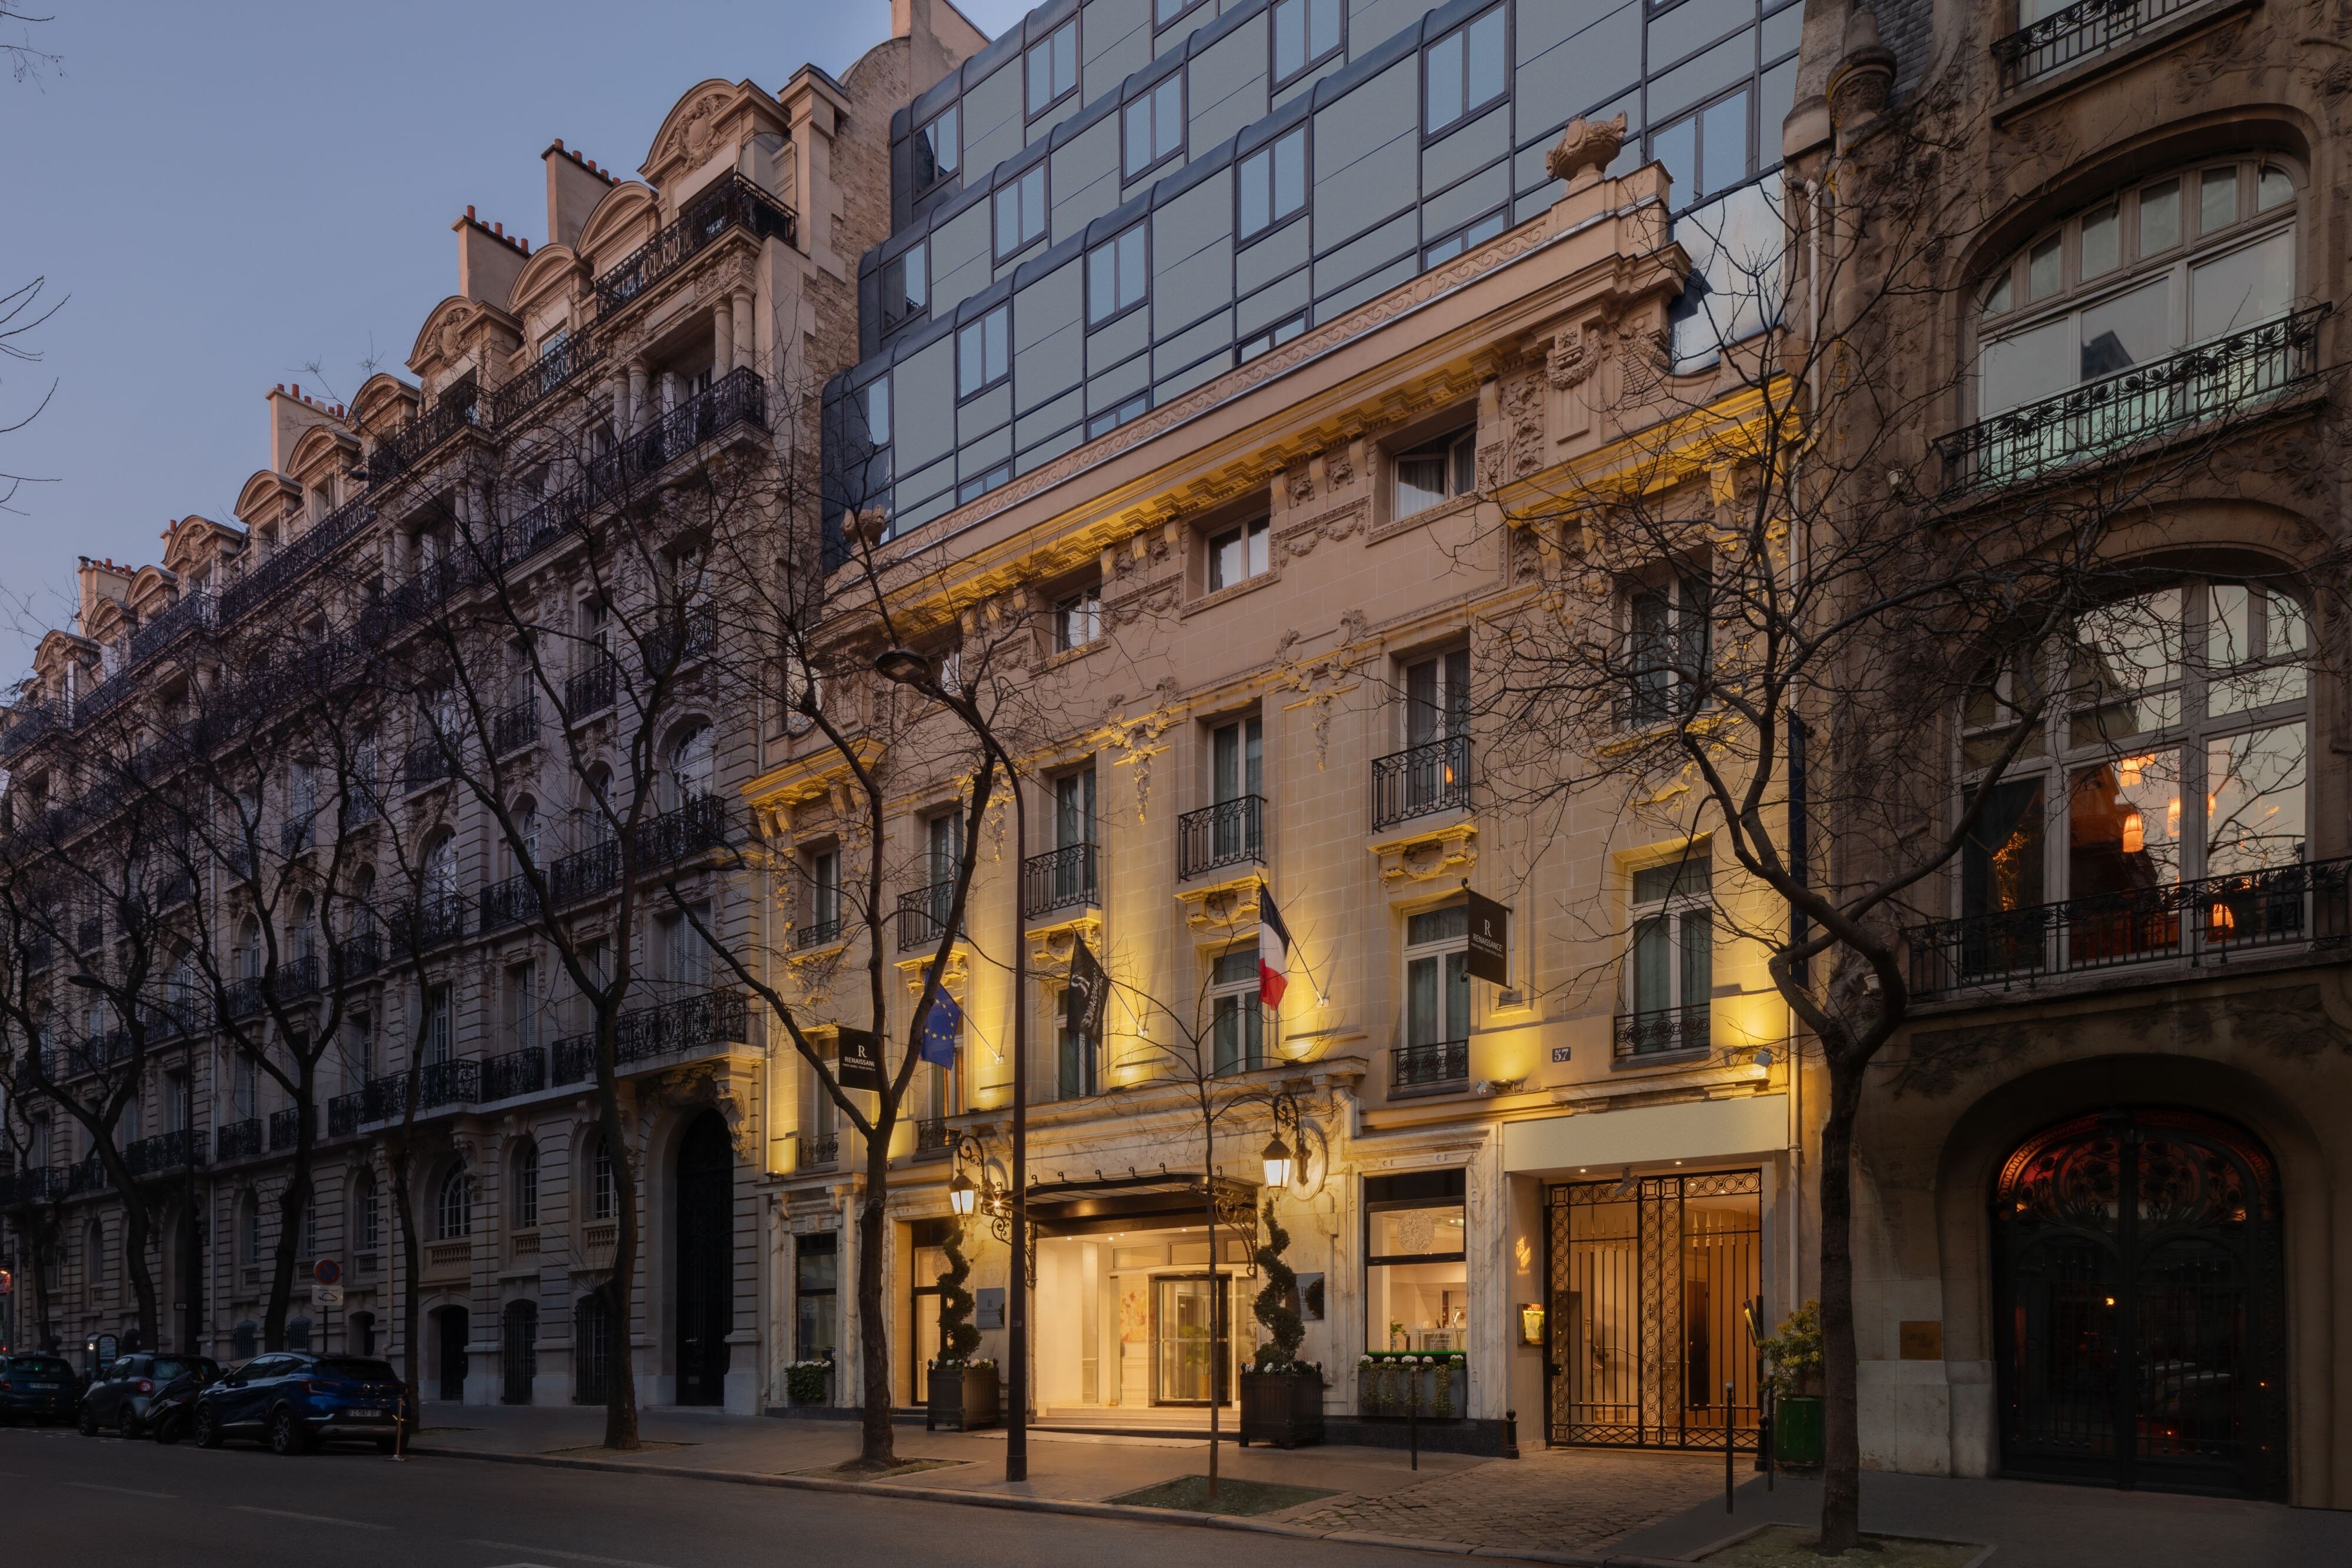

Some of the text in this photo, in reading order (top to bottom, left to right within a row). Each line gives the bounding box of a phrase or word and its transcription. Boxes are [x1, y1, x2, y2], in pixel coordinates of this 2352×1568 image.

[1484, 919, 1492, 937] R
[857, 1045, 868, 1058] R
[1554, 1048, 1569, 1061] 57
[844, 1056, 875, 1067] RENAISSANC
[987, 1299, 993, 1308] R
